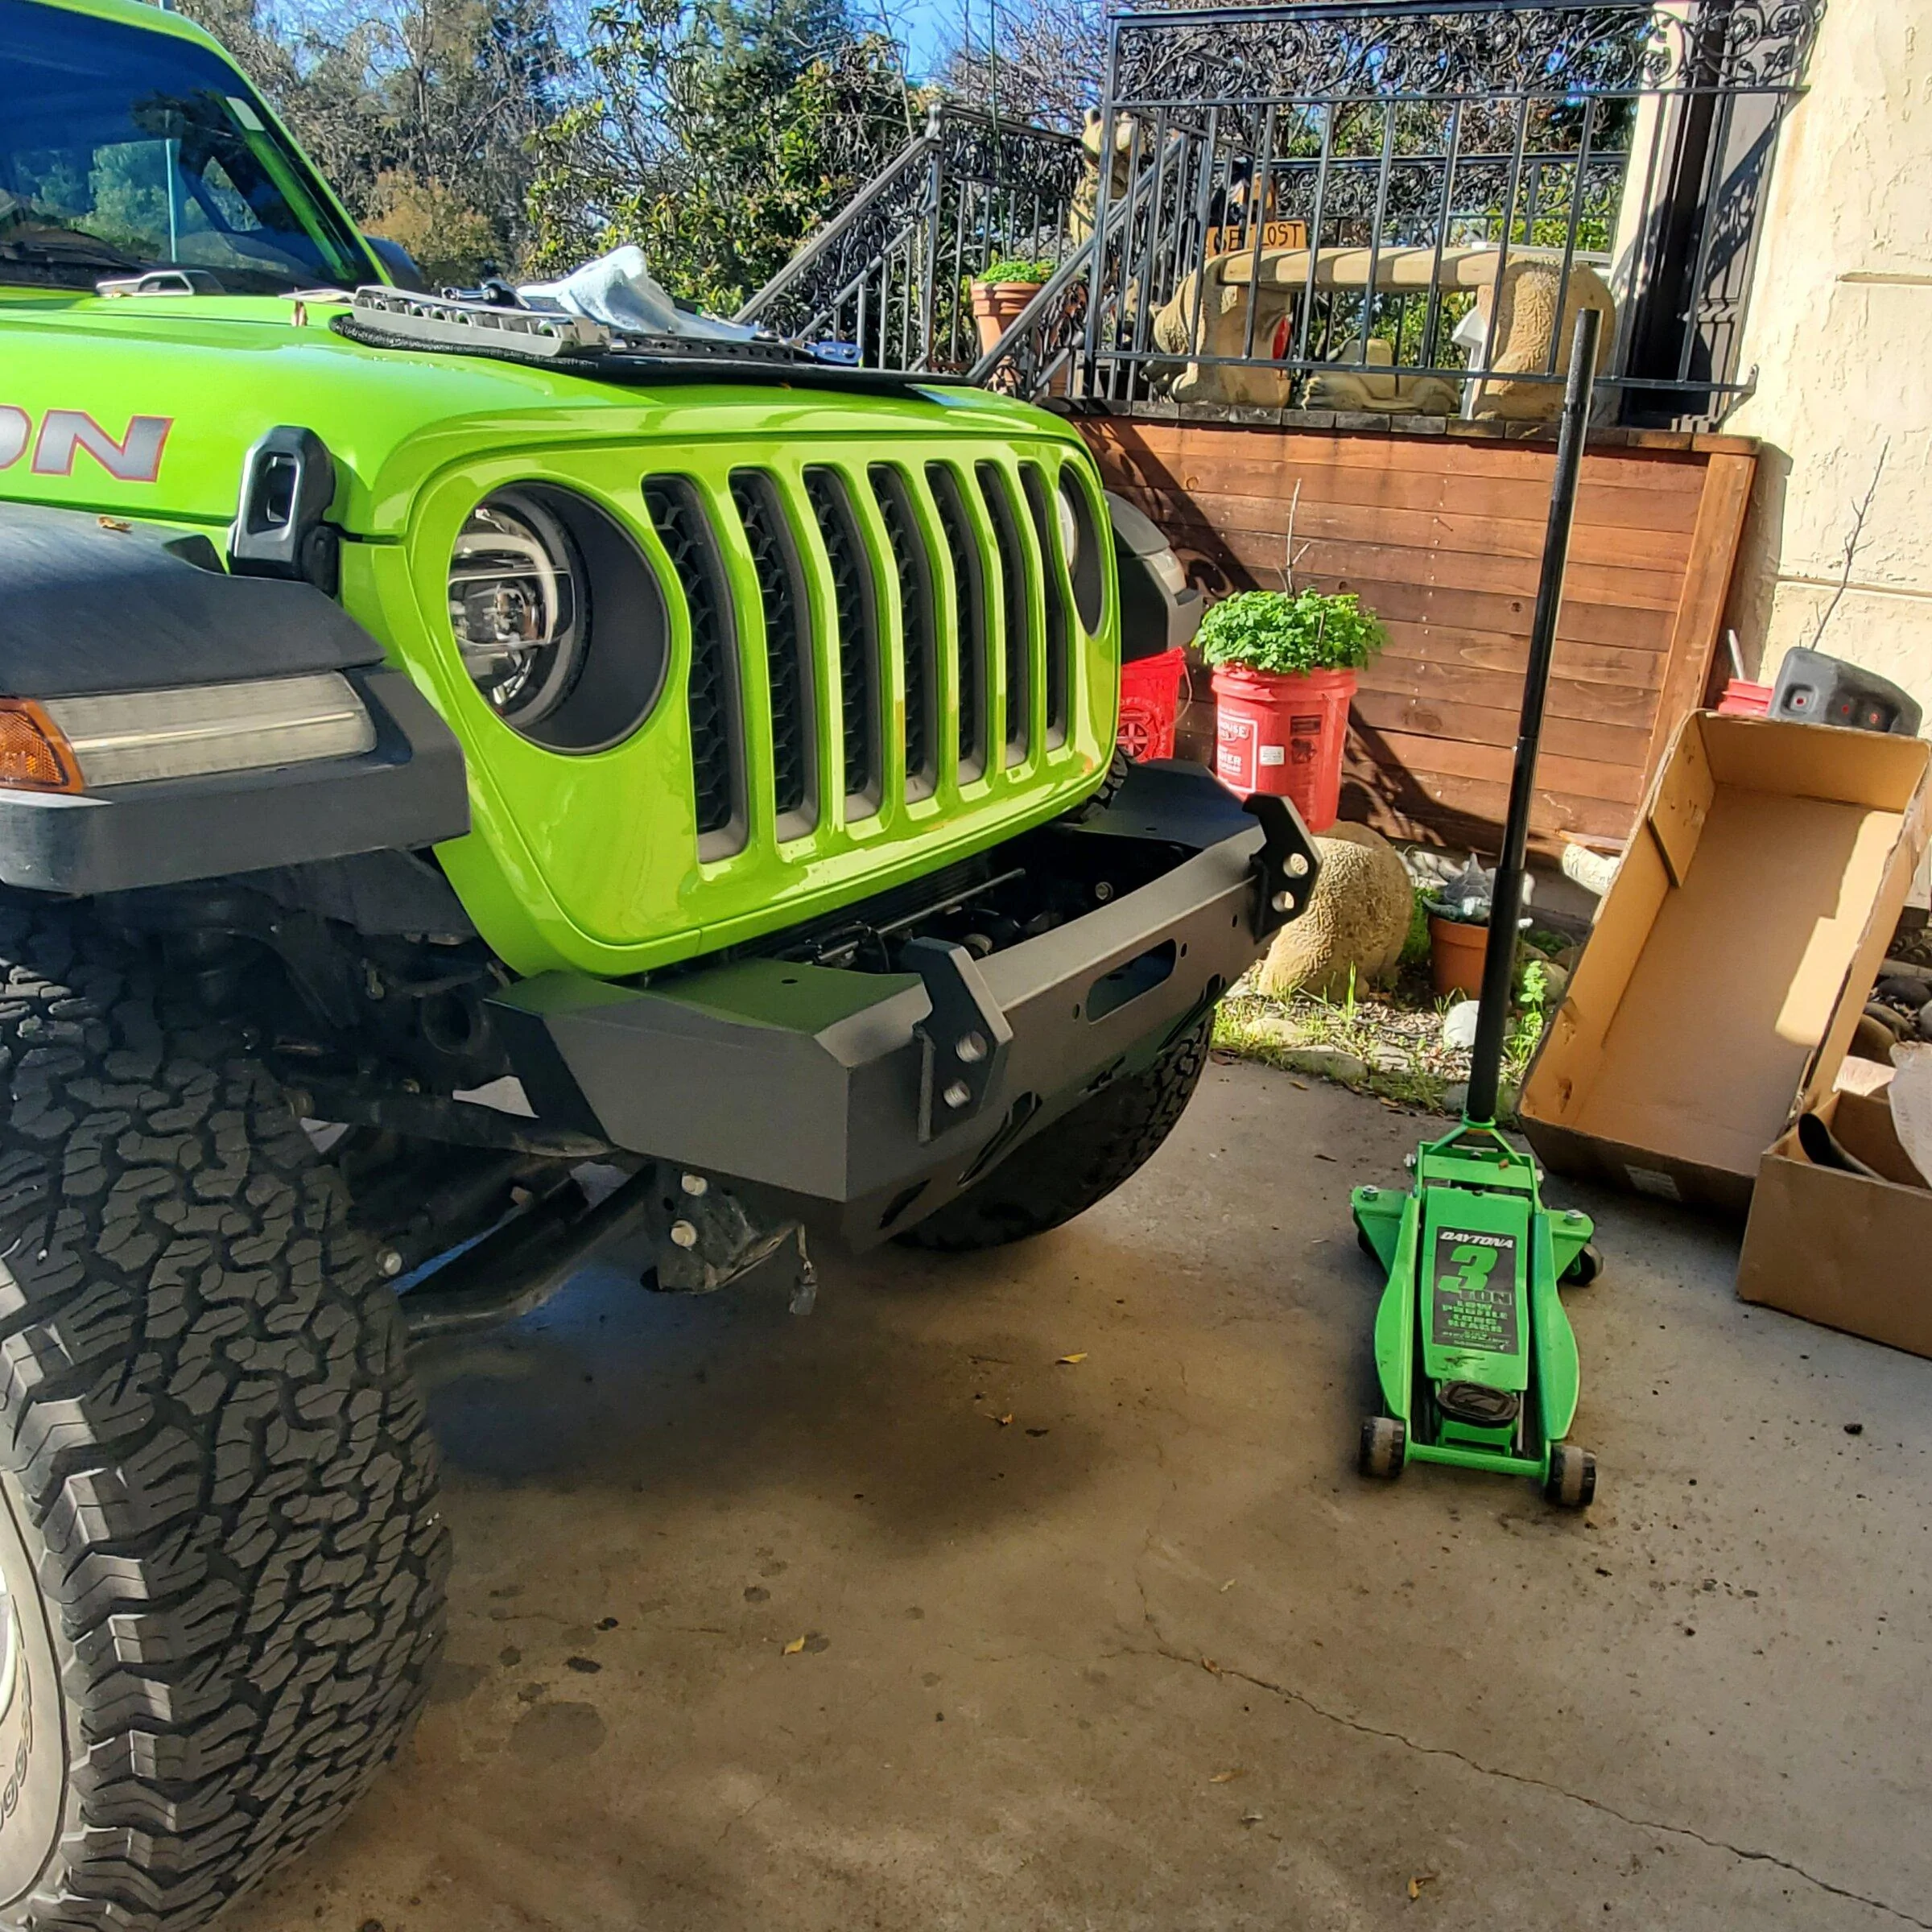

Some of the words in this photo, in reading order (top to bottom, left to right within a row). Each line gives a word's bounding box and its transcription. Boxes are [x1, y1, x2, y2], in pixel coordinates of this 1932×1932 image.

[1440, 1231, 1513, 1249] DAYTONA
[1438, 1245, 1498, 1294] 3
[1459, 1289, 1513, 1306] TON
